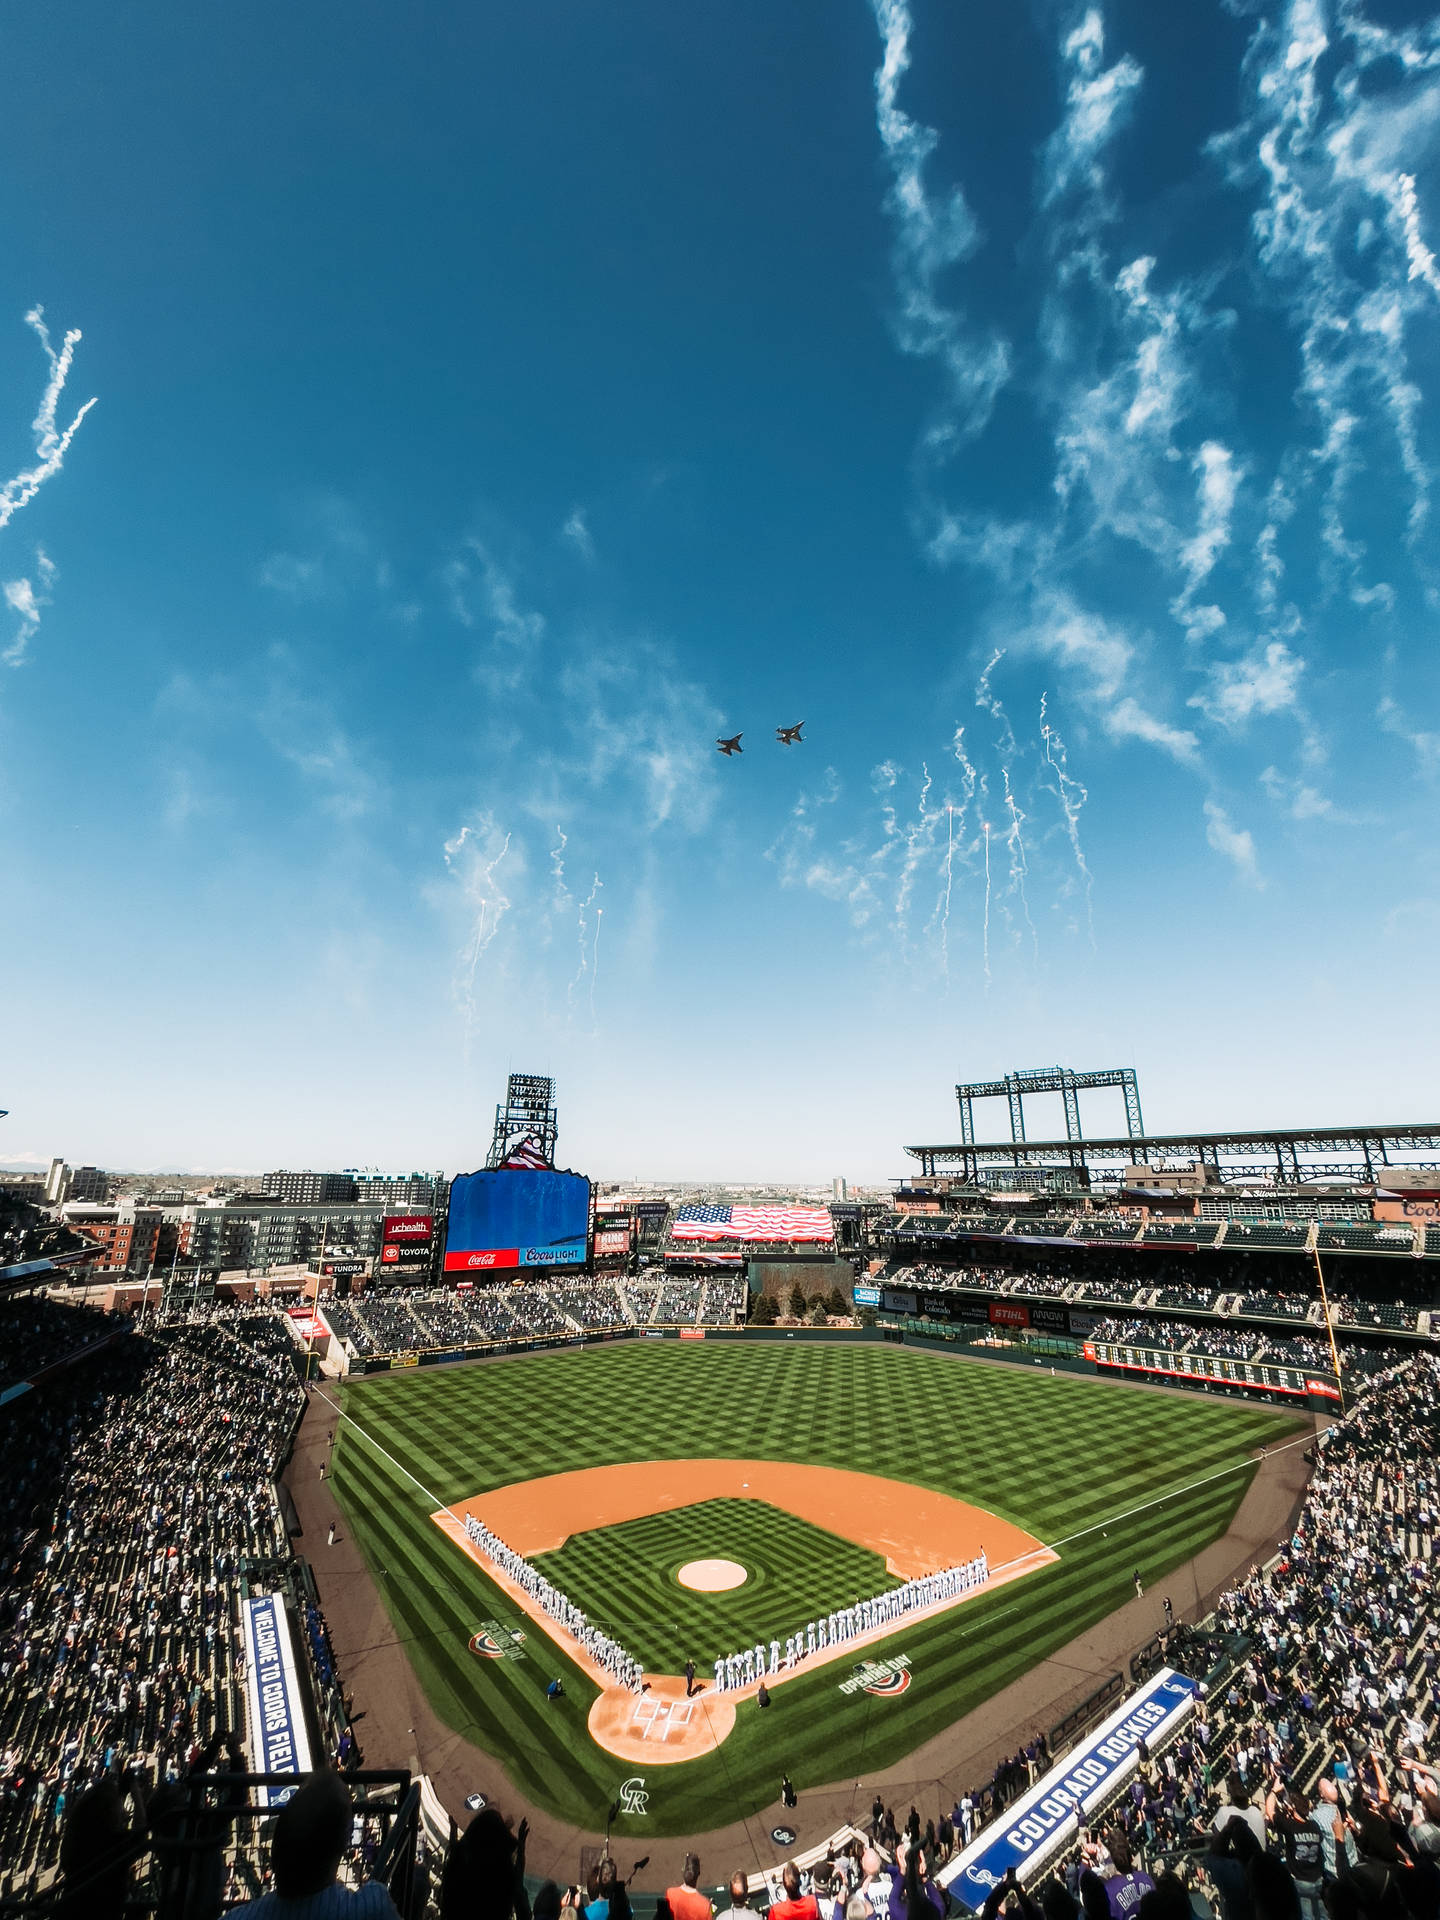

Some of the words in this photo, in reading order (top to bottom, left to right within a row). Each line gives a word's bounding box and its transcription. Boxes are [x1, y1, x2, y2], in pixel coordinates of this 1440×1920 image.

[1401, 1202, 1440, 1216] Coo
[391, 1222, 427, 1232] uchealth
[400, 1248, 430, 1256] TOYOTA
[526, 1248, 554, 1261] Coors
[556, 1250, 578, 1259] LIGHT
[334, 1265, 363, 1273] TUNDRA
[924, 1298, 938, 1306] Bank
[924, 1306, 950, 1314] Colorado
[995, 1309, 1024, 1320] STIHL
[1032, 1310, 1064, 1320] ARROW
[255, 1609, 276, 1664] WELCOME
[480, 1620, 516, 1648] OPENING
[504, 1646, 528, 1661] DAY
[260, 1662, 280, 1683] TO
[838, 1664, 892, 1695] OPENING
[888, 1654, 912, 1670] DAY
[262, 1682, 288, 1732] COORS
[1007, 1758, 1108, 1852] COLORADO
[1097, 1701, 1166, 1763] ROCKIES
